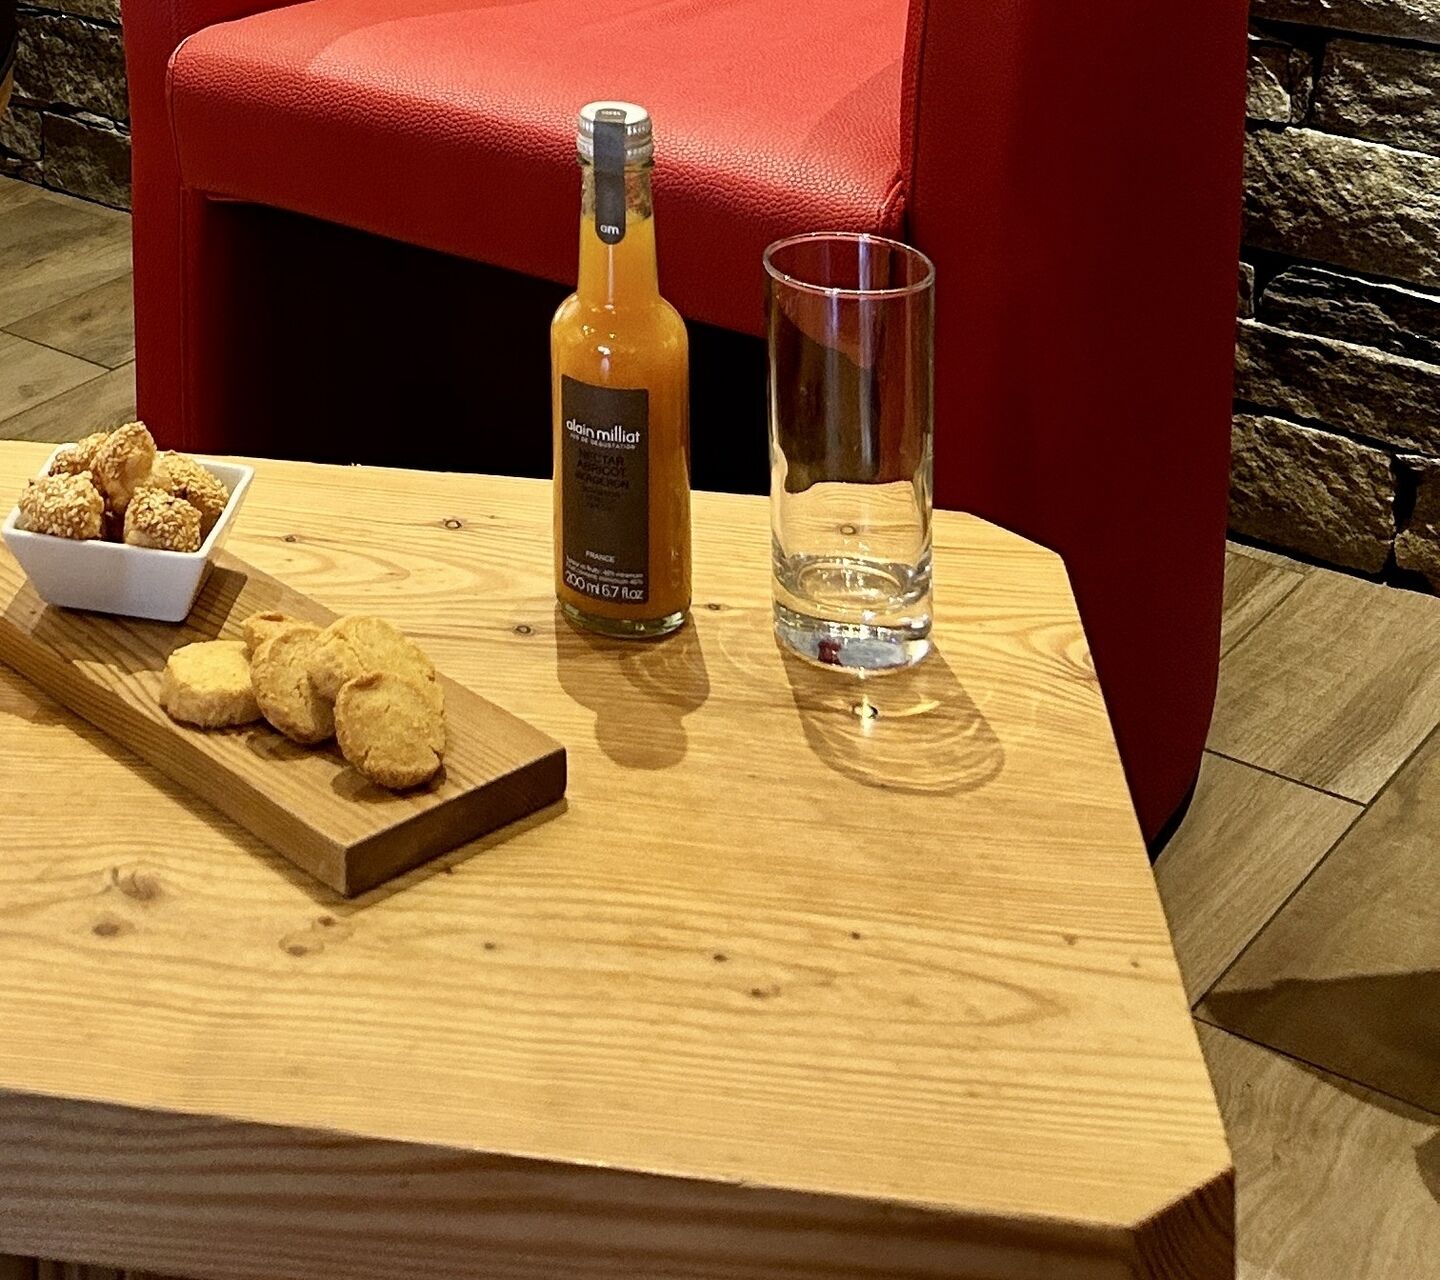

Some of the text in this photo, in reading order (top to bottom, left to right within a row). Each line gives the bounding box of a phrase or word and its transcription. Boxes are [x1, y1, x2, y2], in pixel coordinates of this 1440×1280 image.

[600, 224, 620, 236] am
[566, 418, 640, 443] alain milliat
[565, 570, 586, 590] 200
[586, 582, 600, 595] ml
